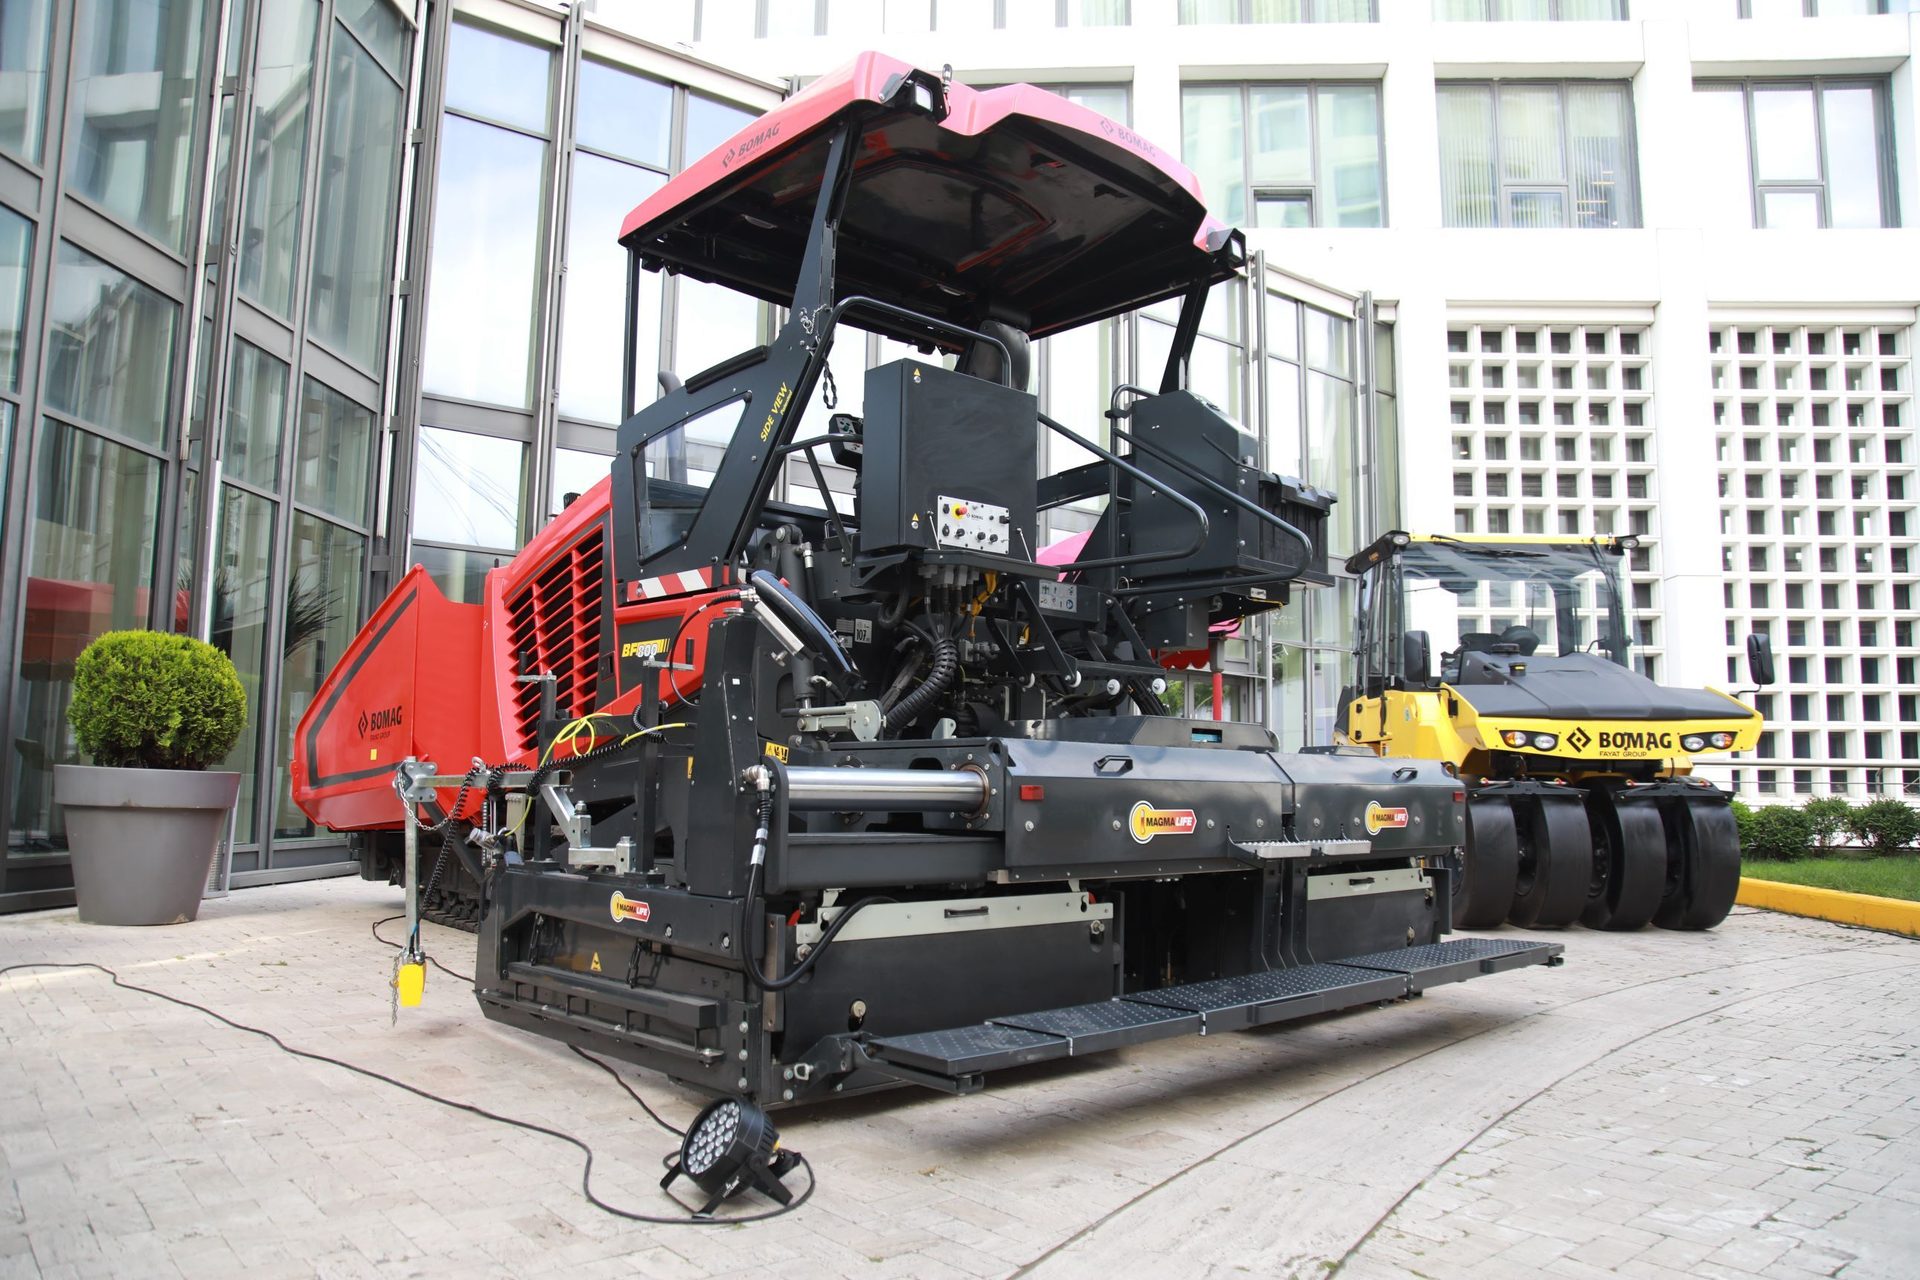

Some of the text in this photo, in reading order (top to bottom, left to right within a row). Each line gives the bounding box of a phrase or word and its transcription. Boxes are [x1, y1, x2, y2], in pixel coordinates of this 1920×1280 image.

[738, 121, 781, 157] BOMAG
[1118, 127, 1156, 157] BOMAG
[760, 381, 787, 442] SIDE VIEW
[856, 629, 867, 641] 107
[370, 705, 402, 731] BOMAG
[1599, 731, 1672, 749] BOMAG
[1623, 750, 1647, 758] GROUP
[1146, 816, 1193, 827] MAGMALIFE
